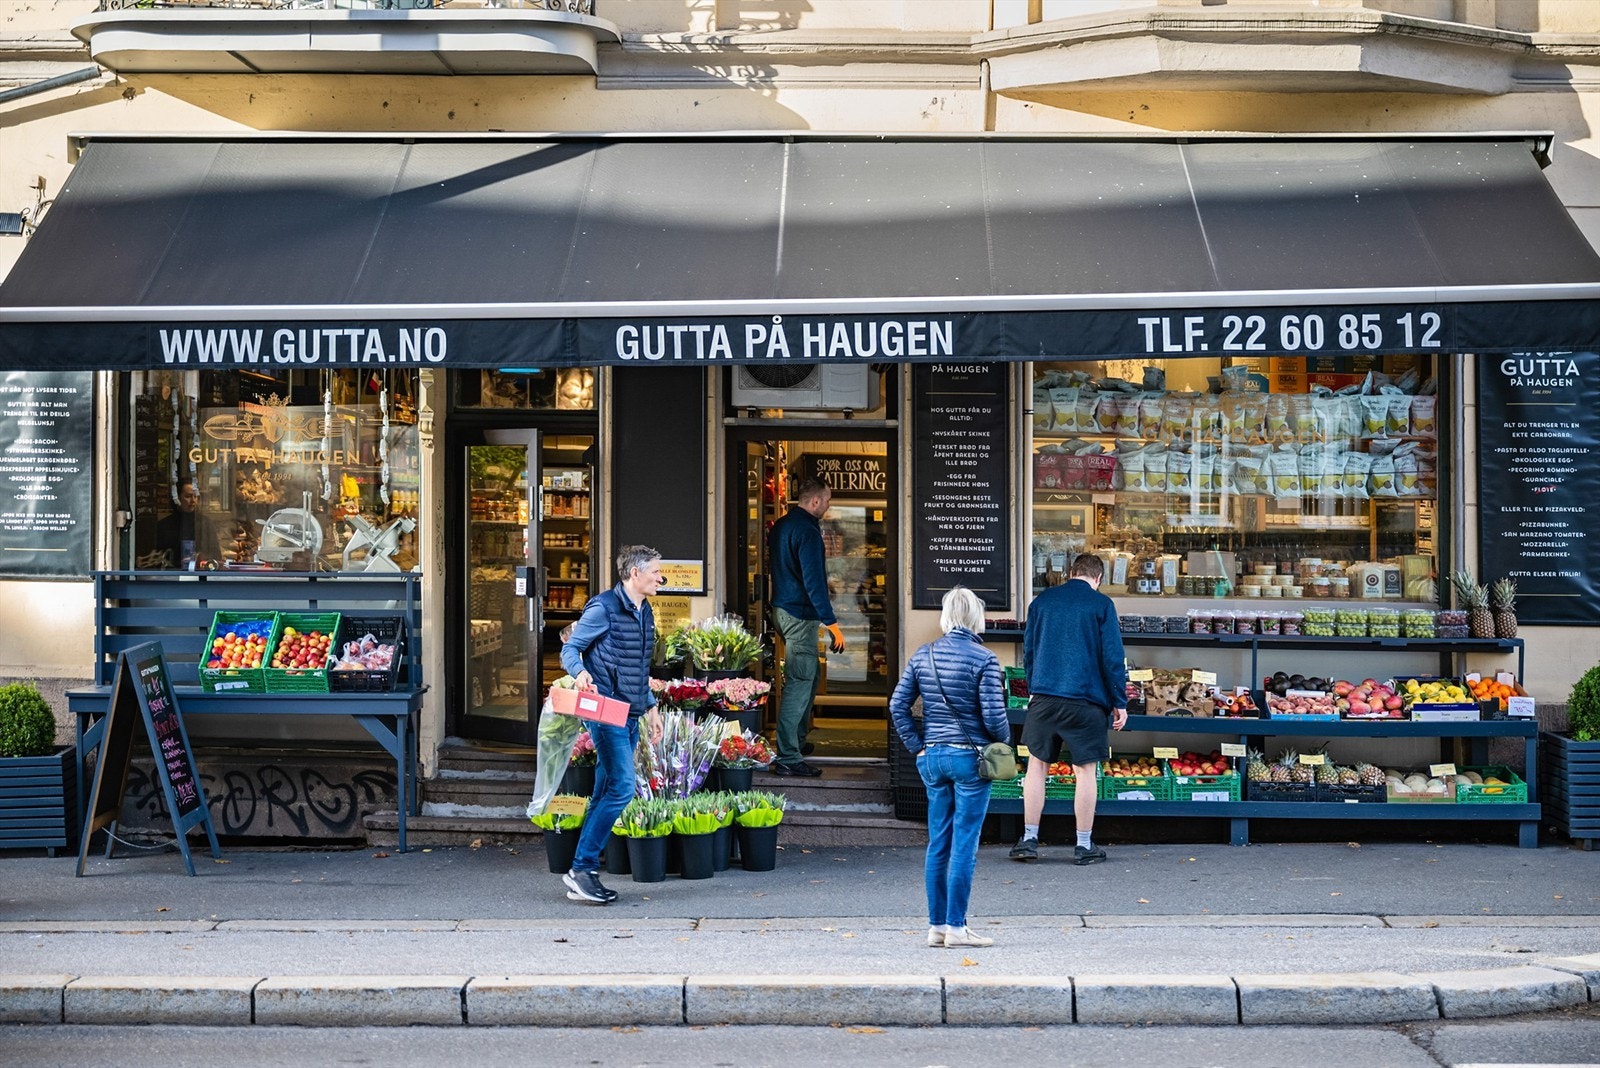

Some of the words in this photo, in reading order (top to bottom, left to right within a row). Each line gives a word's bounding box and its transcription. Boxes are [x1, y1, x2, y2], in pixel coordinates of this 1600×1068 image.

[616, 325, 732, 359] GUTTA
[746, 316, 791, 358] PÅ
[804, 321, 953, 357] HAUGEN
[1137, 317, 1208, 352] TLF.
[1222, 315, 1266, 350] 22
[1280, 314, 1324, 350] 60
[1338, 313, 1382, 349] 85
[1396, 312, 1440, 347] 12
[160, 327, 446, 362] WWW.GUTTA.NO
[932, 363, 944, 373] PÅ
[946, 365, 989, 373] HAUGEN
[1500, 359, 1580, 376] GUTTA
[9, 385, 21, 393] GÅR
[1510, 376, 1524, 387] PÅ
[1527, 378, 1573, 387] HAUGEN
[1142, 426, 1217, 443] GUTTA
[1230, 428, 1327, 444] HAUGEN
[188, 448, 258, 466] GUTTA
[271, 448, 361, 466] HAUGEN
[816, 459, 841, 471] SPØR
[845, 459, 861, 471] OSS
[864, 459, 880, 471] OM
[1090, 457, 1110, 466] REAL
[817, 471, 886, 491] ATERING
[941, 544, 995, 552] TÅRNBRENNERIET
